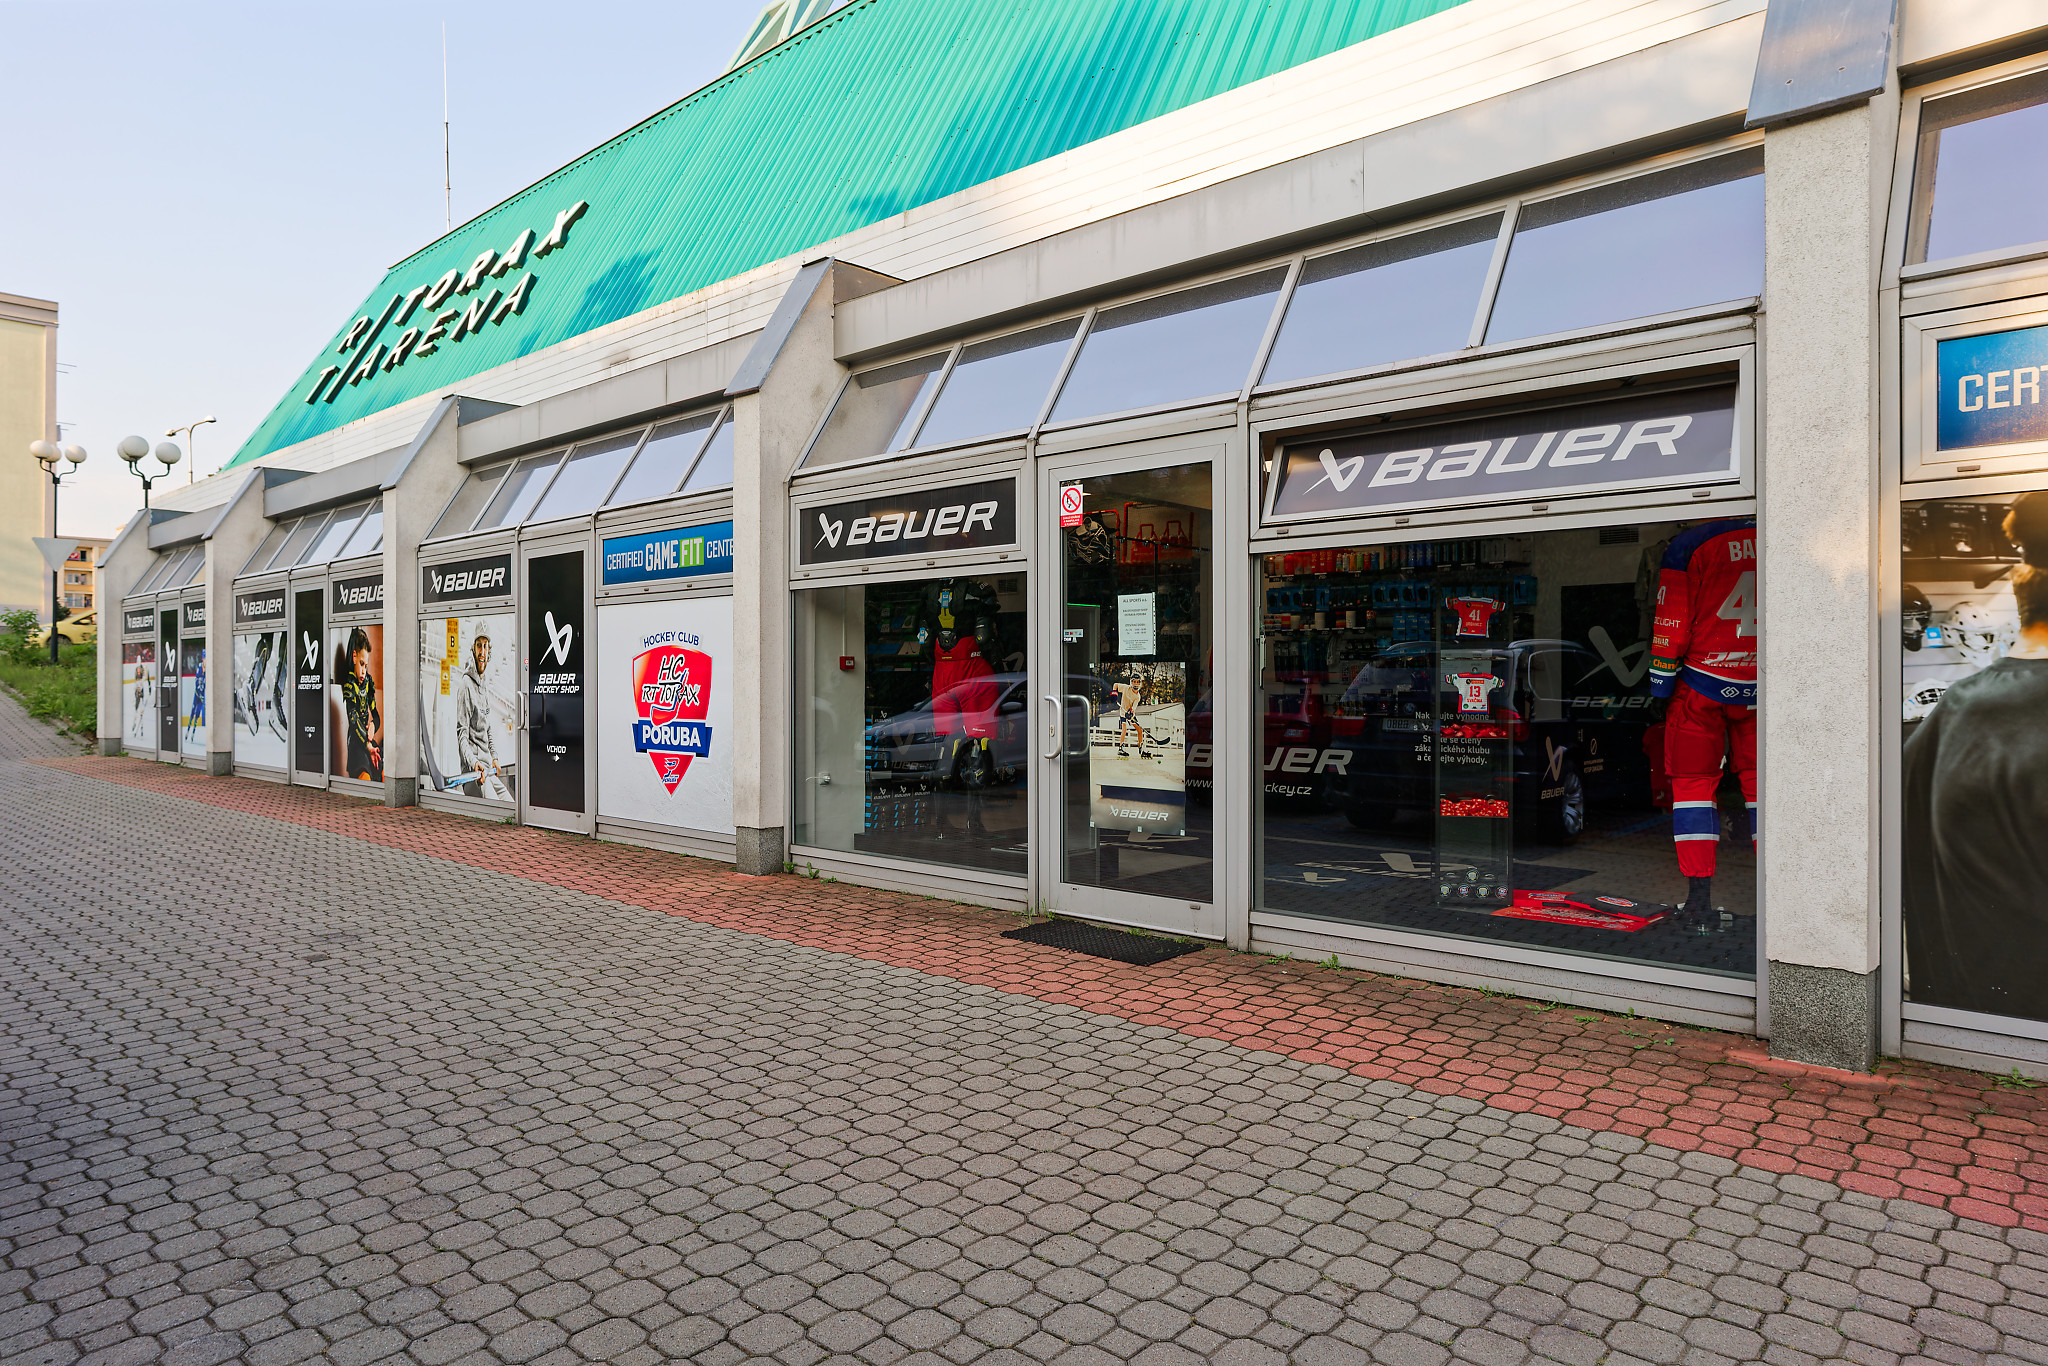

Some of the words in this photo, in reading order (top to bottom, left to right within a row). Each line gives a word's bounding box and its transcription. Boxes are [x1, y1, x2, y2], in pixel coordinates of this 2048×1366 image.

[393, 199, 590, 327] TORAX
[347, 271, 540, 387] ARENA
[1958, 365, 2048, 412] CER
[1367, 415, 1694, 488] BAUER
[846, 500, 999, 546] BAUER
[606, 550, 644, 571] CERTIFIED
[645, 540, 679, 572] GAME
[681, 537, 704, 567] FIT
[1728, 538, 1757, 562] BA
[443, 567, 506, 593] BAUER
[192, 608, 205, 622] BA
[247, 598, 283, 616] BAUER
[1469, 609, 1480, 621] 41
[643, 631, 677, 648] HOCKEY
[677, 631, 700, 646] CLUB
[659, 655, 685, 682] HC
[1653, 658, 1679, 669] Chan
[539, 673, 576, 684] BAUER
[534, 685, 559, 694] HOCKEY
[561, 685, 580, 694] SHOP
[1469, 685, 1481, 697] 13
[643, 725, 702, 748] PORUBA
[546, 745, 567, 754] VCHOD
[1467, 745, 1490, 754] klubu
[1456, 755, 1488, 766] výhody.
[1540, 786, 1565, 800] BAUER
[1120, 809, 1169, 822] BAUER
